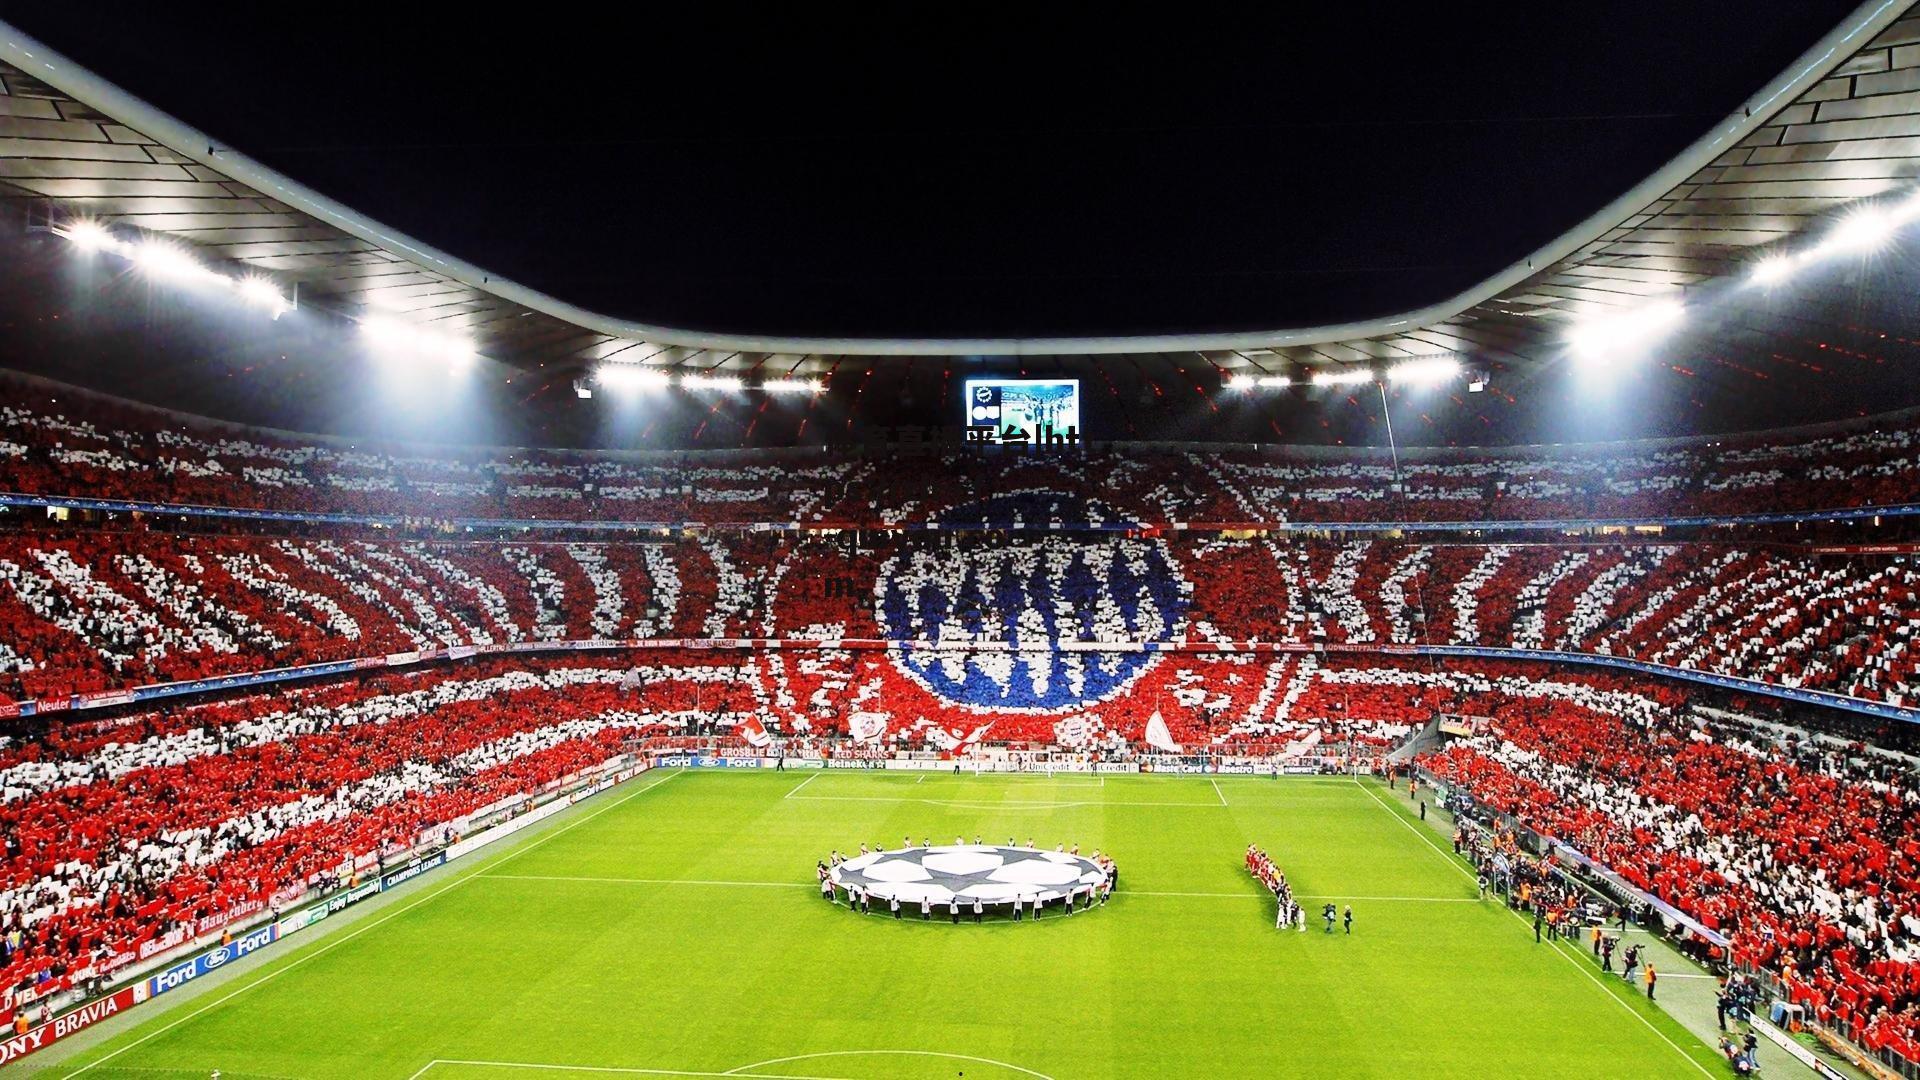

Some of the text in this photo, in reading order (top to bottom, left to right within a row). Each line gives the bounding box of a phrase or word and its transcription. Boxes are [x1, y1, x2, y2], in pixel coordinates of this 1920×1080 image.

[661, 757, 691, 767] Ford
[727, 758, 757, 767] Ford
[387, 856, 442, 887] CHAMPIONS LEAGUE
[329, 898, 346, 911] Enjoy
[238, 928, 270, 956] Ford
[157, 960, 197, 992] Ford
[55, 998, 118, 1038] BRAVIA
